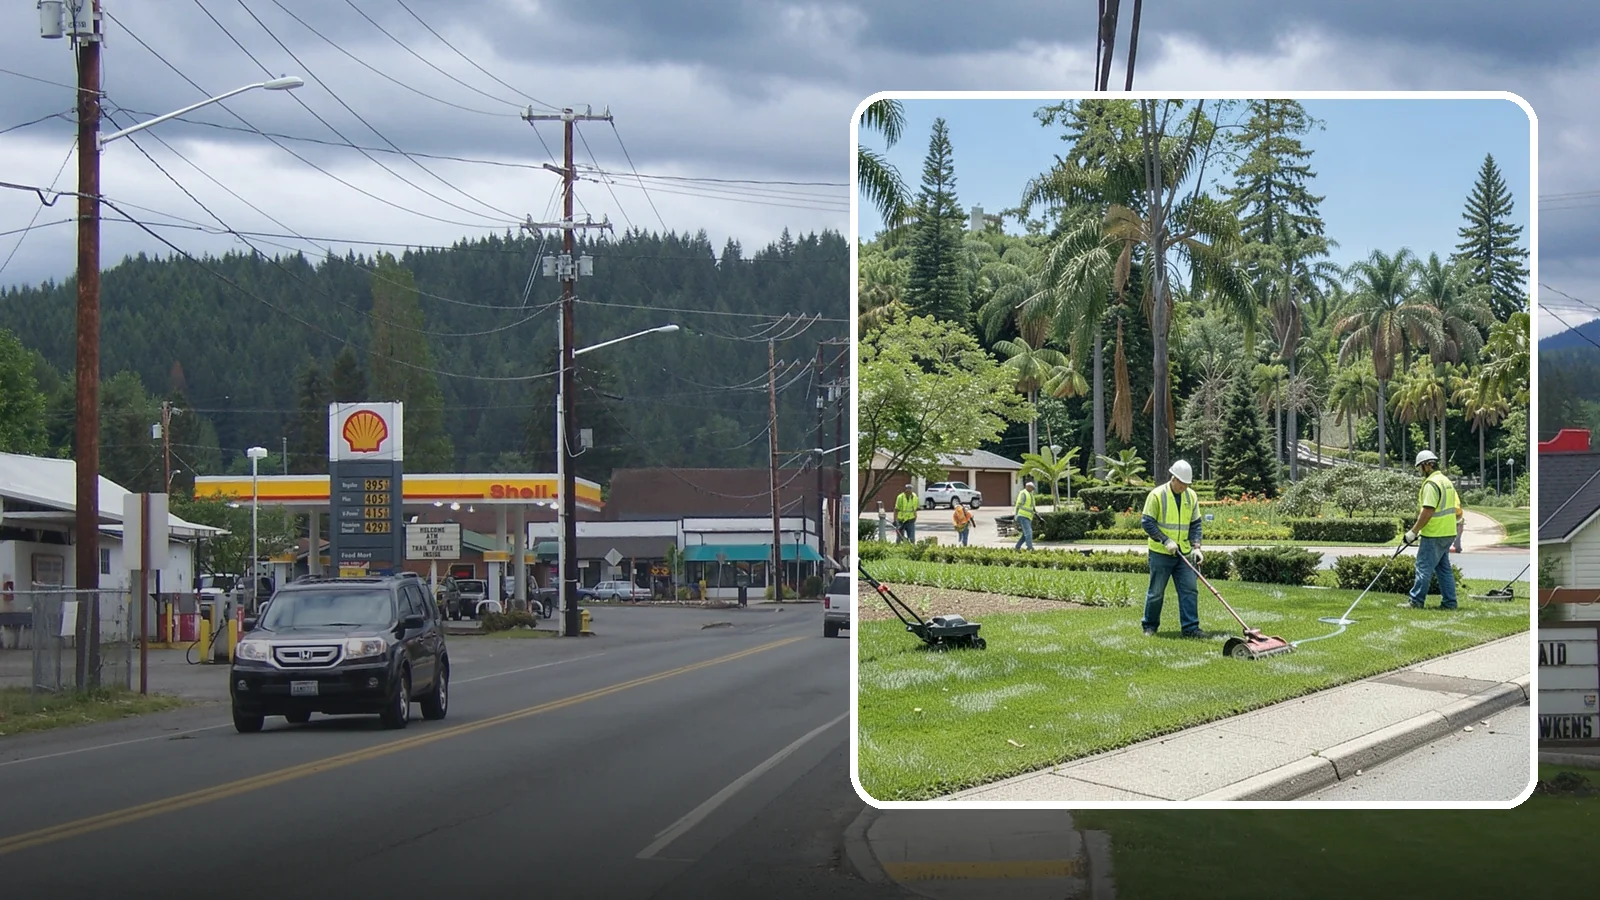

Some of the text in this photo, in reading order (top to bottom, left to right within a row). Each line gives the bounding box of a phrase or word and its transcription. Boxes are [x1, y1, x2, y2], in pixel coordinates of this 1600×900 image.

[366, 480, 383, 490] 395
[490, 484, 547, 499] Shell
[366, 494, 383, 504] 405
[366, 508, 383, 518] 415
[366, 523, 383, 533] 429
